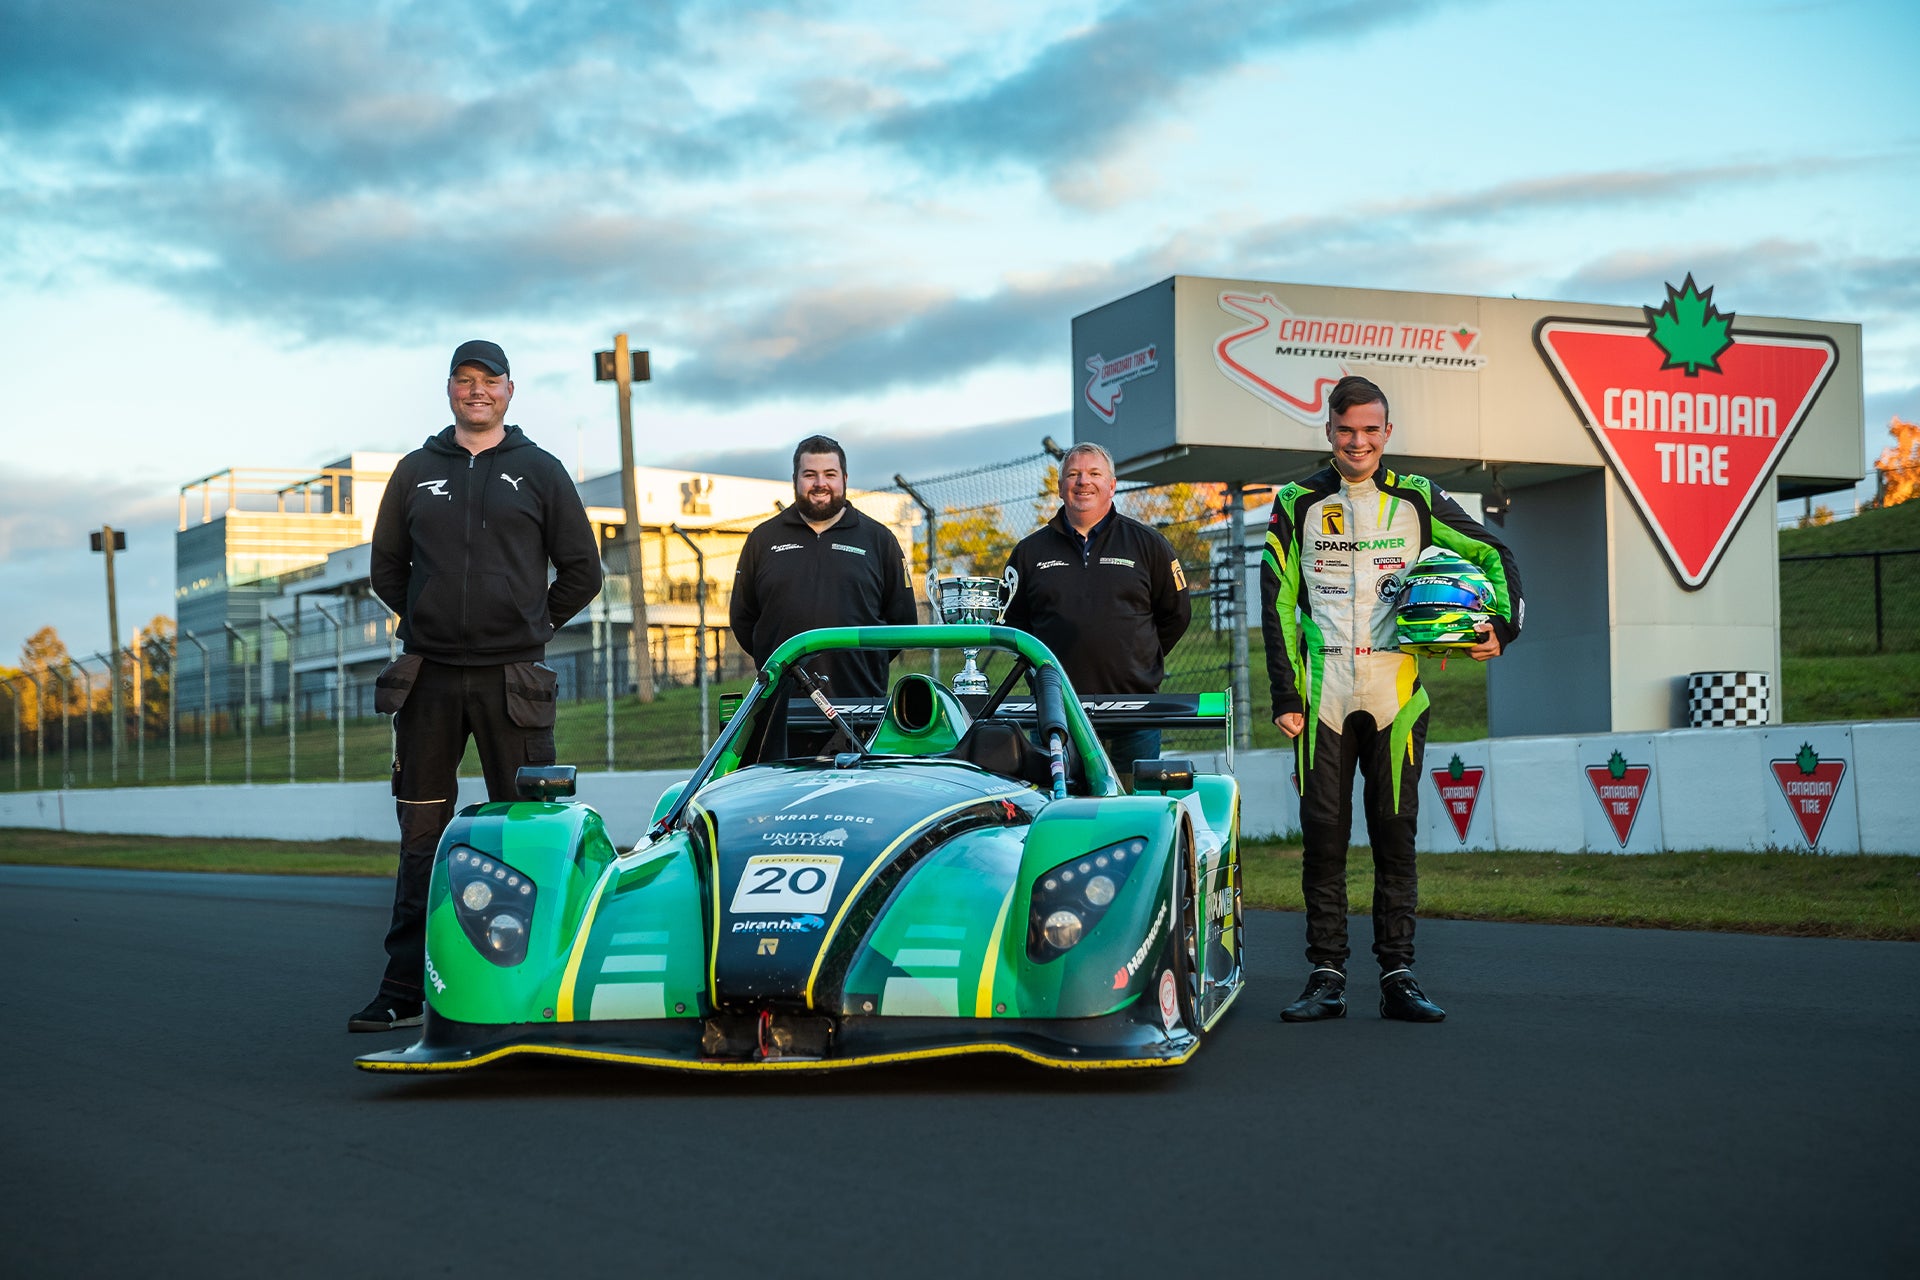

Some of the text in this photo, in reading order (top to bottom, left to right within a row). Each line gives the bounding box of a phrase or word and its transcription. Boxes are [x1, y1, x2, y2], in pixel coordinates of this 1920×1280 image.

[1279, 319, 1447, 351] CANADIAN TIRE
[1275, 346, 1477, 367] MOTORSPORT PARK
[1603, 387, 1778, 438] CANADIAN
[1655, 442, 1730, 486] TIRE
[1314, 538, 1405, 552] SPARKPOWER
[1442, 786, 1474, 799] CANADIAN
[1600, 785, 1639, 800] CANADIAN
[1786, 781, 1832, 797] CANADIAN
[1453, 802, 1468, 814] TIRE
[1611, 802, 1630, 815] TIRE
[1800, 798, 1820, 814] TIRE
[824, 814, 875, 824] FORCE
[762, 832, 820, 841] UNITY
[770, 839, 844, 847] AUTISM
[745, 867, 827, 895] 20
[731, 919, 802, 933] piranha
